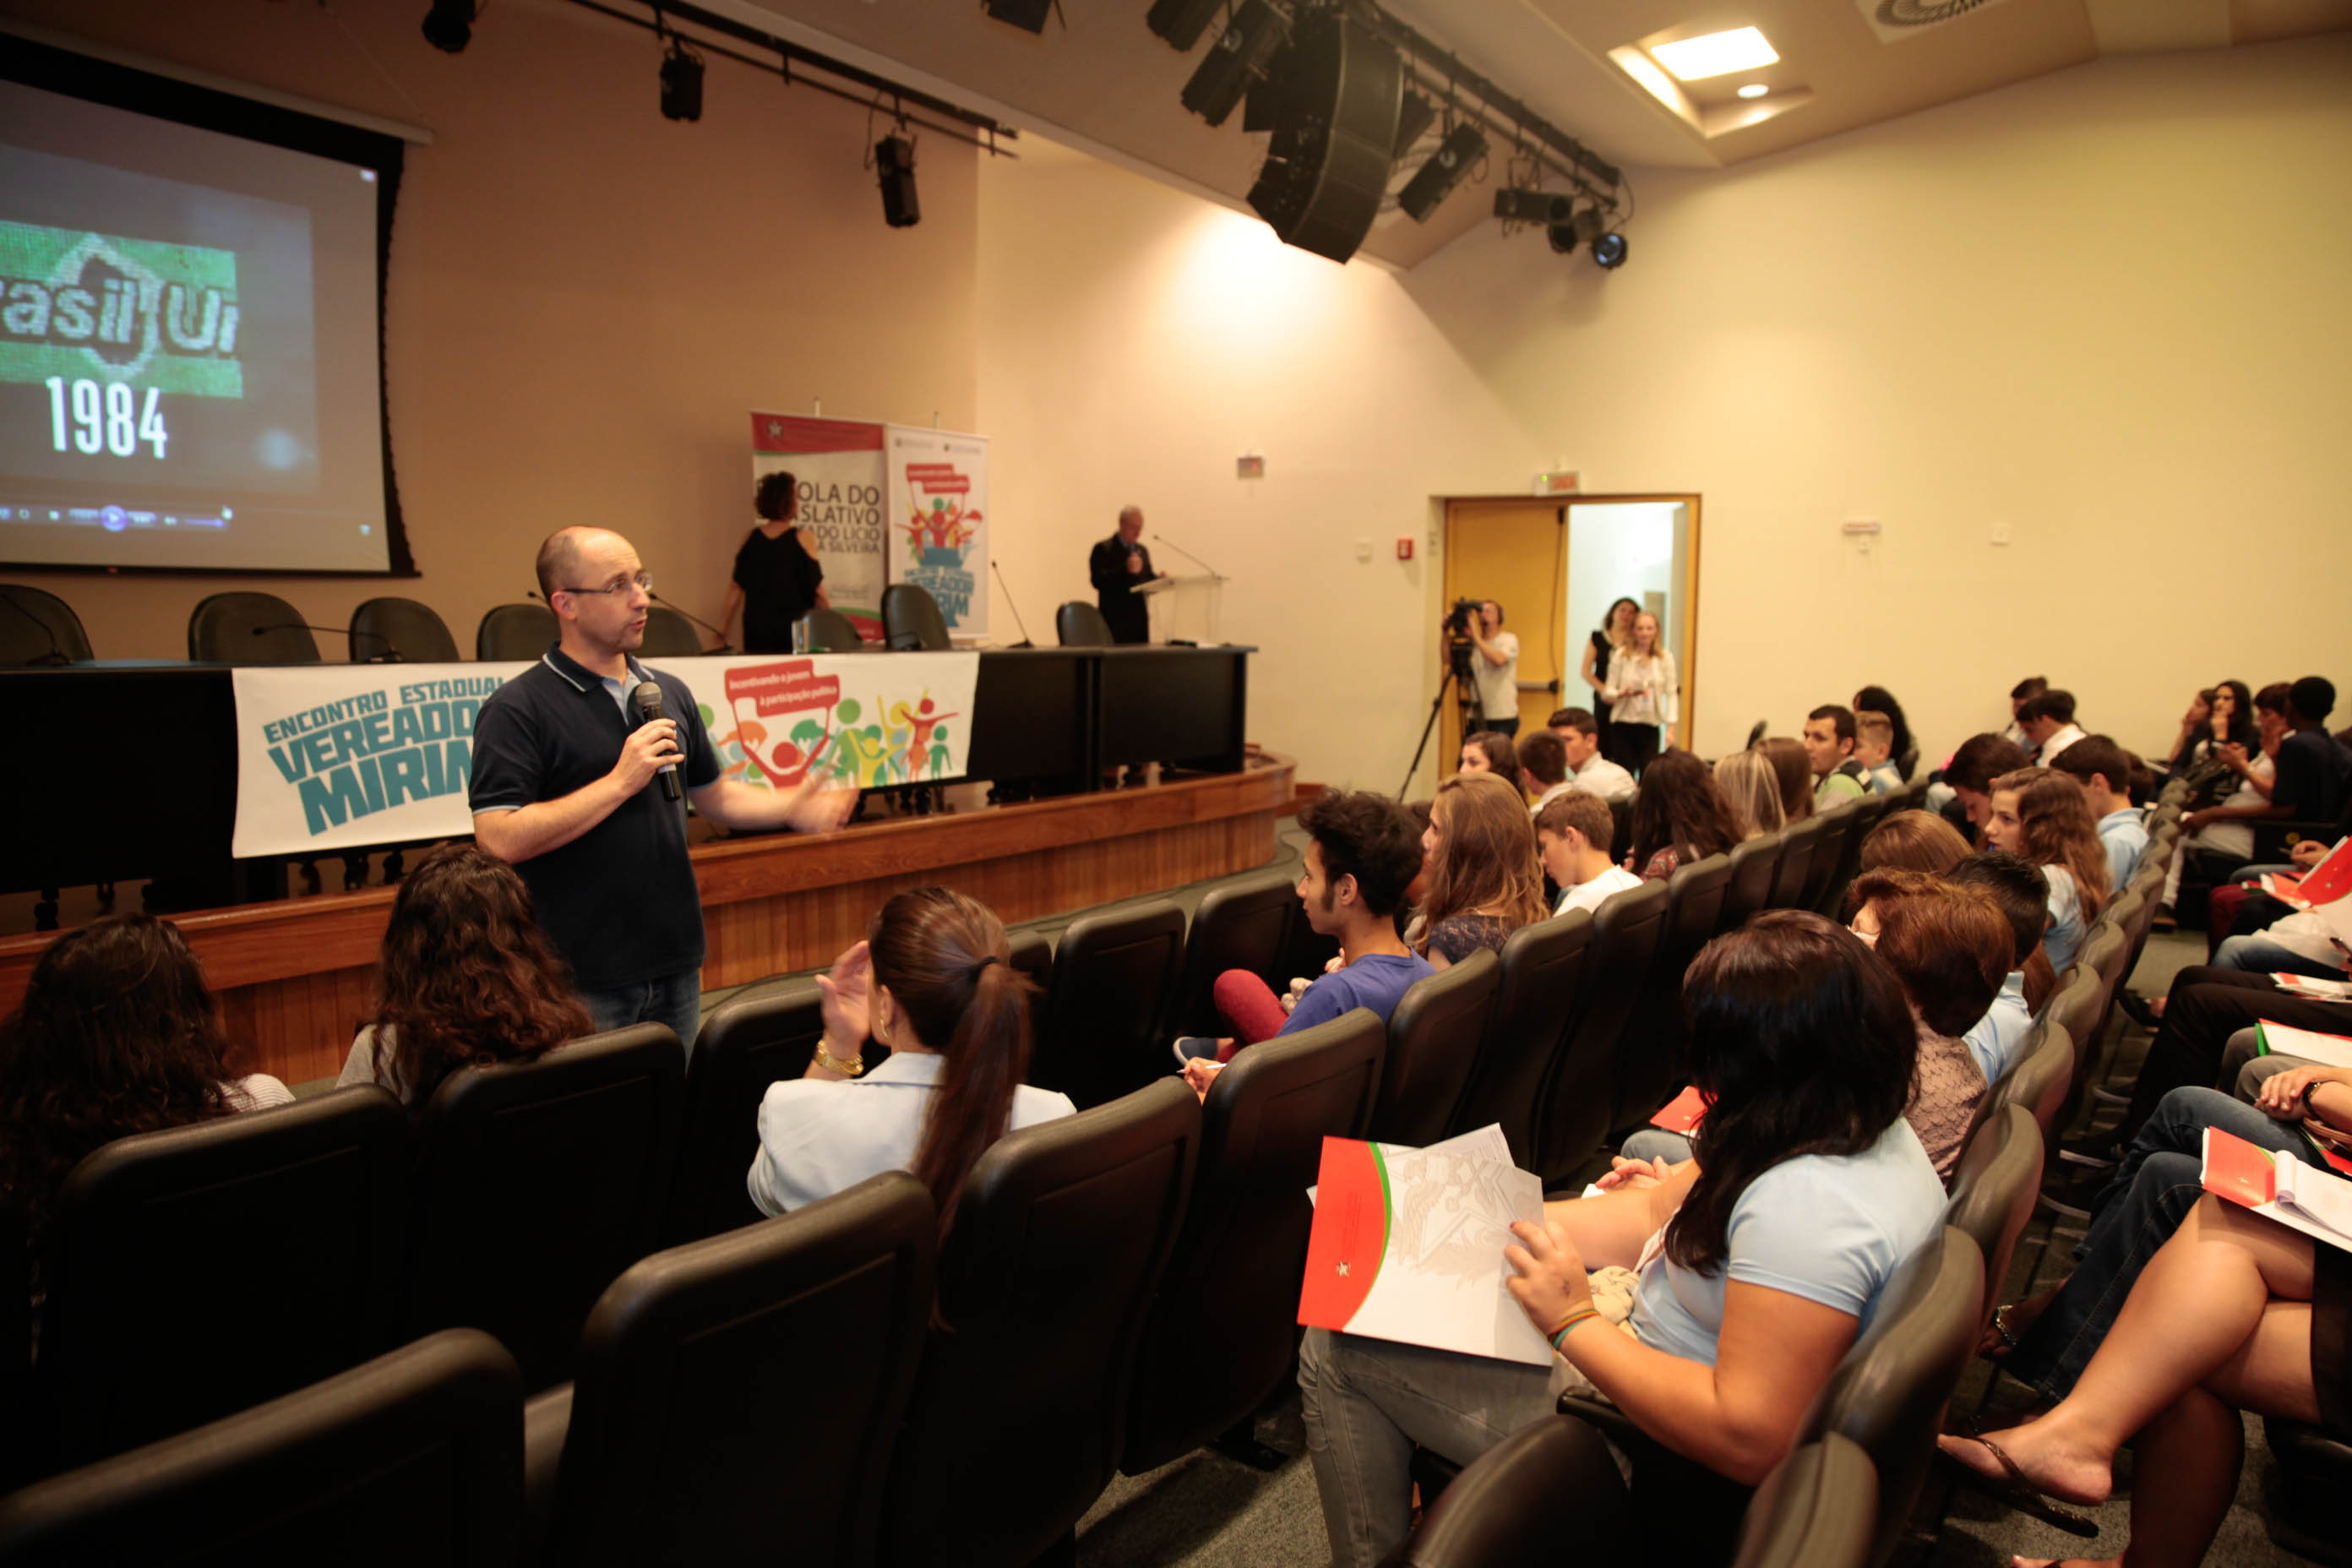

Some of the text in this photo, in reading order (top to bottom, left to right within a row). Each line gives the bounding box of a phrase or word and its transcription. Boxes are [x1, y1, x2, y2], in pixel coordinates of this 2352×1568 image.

[0, 277, 138, 344] asil
[46, 376, 168, 459] 1984
[798, 481, 880, 506] OLA DO
[800, 504, 880, 526] SLATIVO
[263, 689, 388, 744] ENCONTRO
[267, 698, 488, 785] VEREADO
